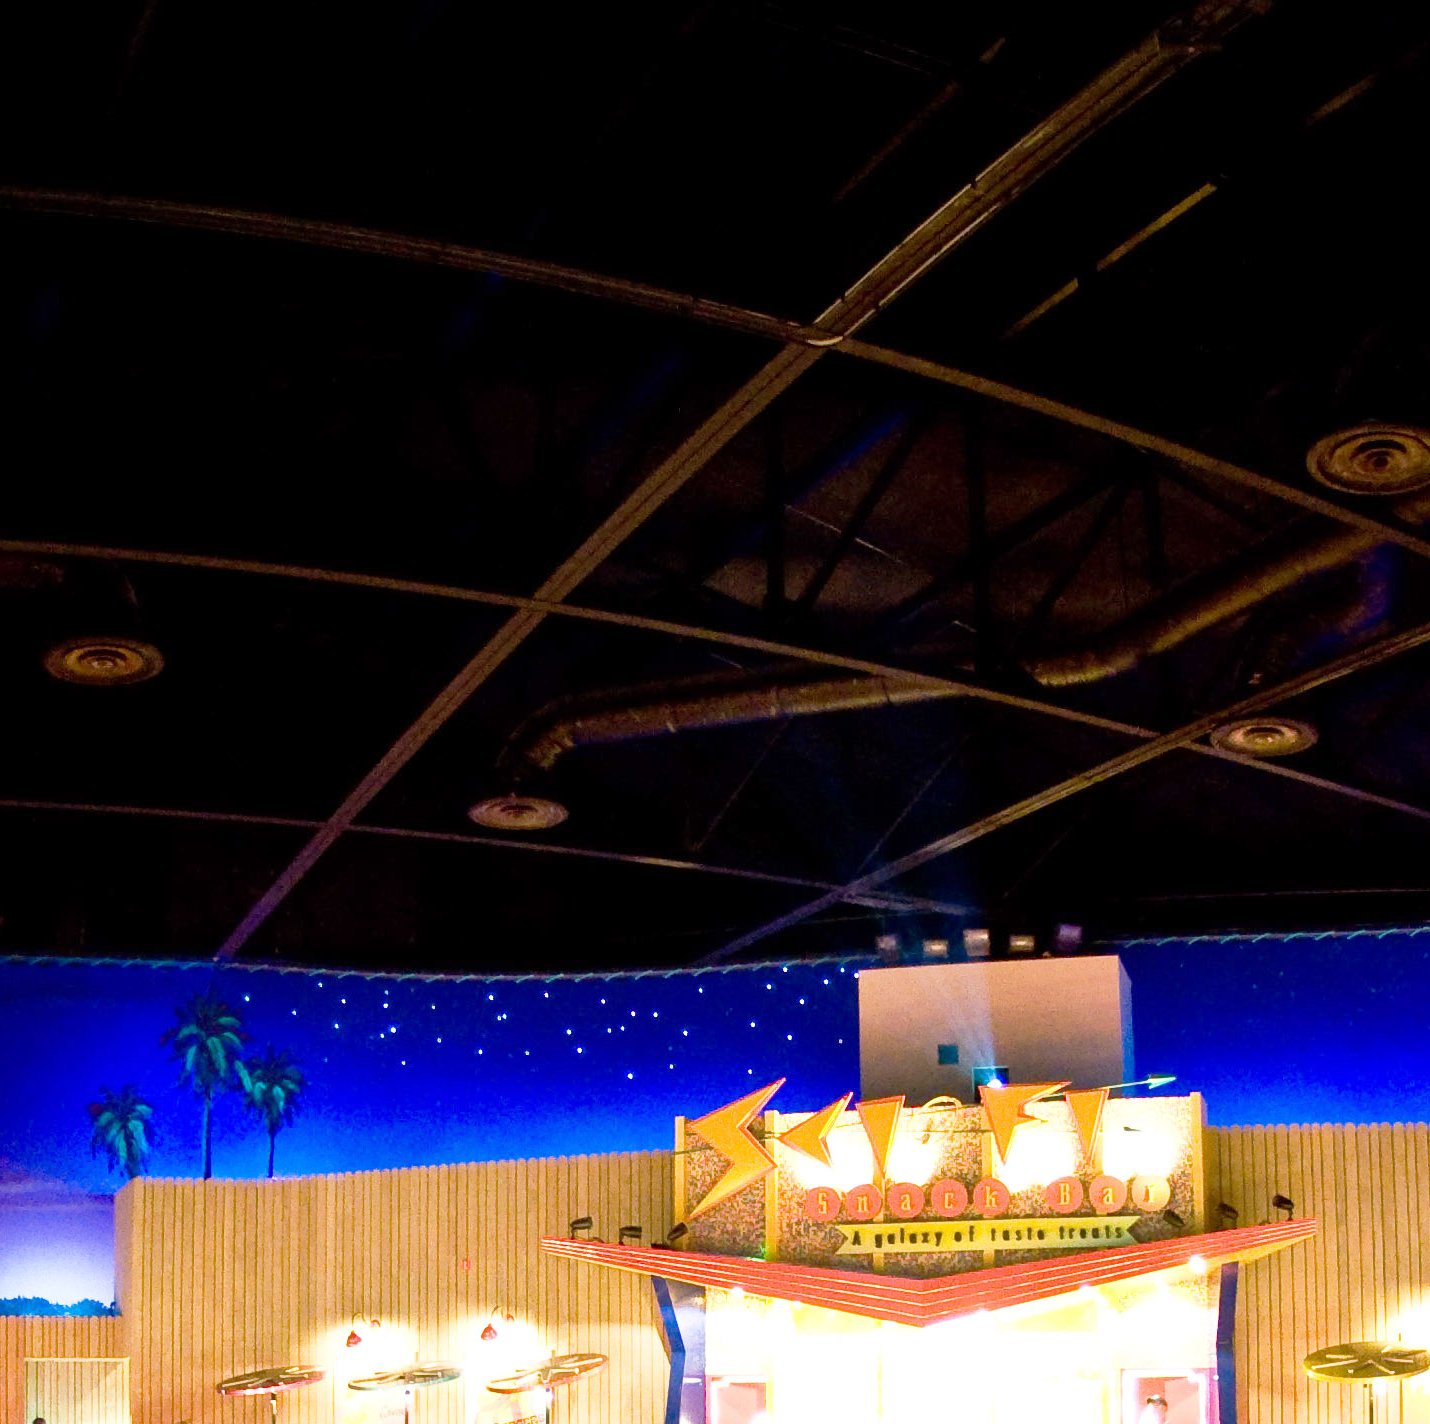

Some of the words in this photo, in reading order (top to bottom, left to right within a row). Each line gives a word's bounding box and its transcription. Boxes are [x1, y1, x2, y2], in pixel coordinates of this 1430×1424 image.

[816, 1178, 999, 1214] Snack
[1058, 1176, 1157, 1206] Bar
[852, 1229, 863, 1246] A
[874, 1227, 944, 1249] galaxy
[953, 1225, 976, 1243] of
[990, 1225, 1046, 1242] taste
[1059, 1224, 1124, 1241] treats
